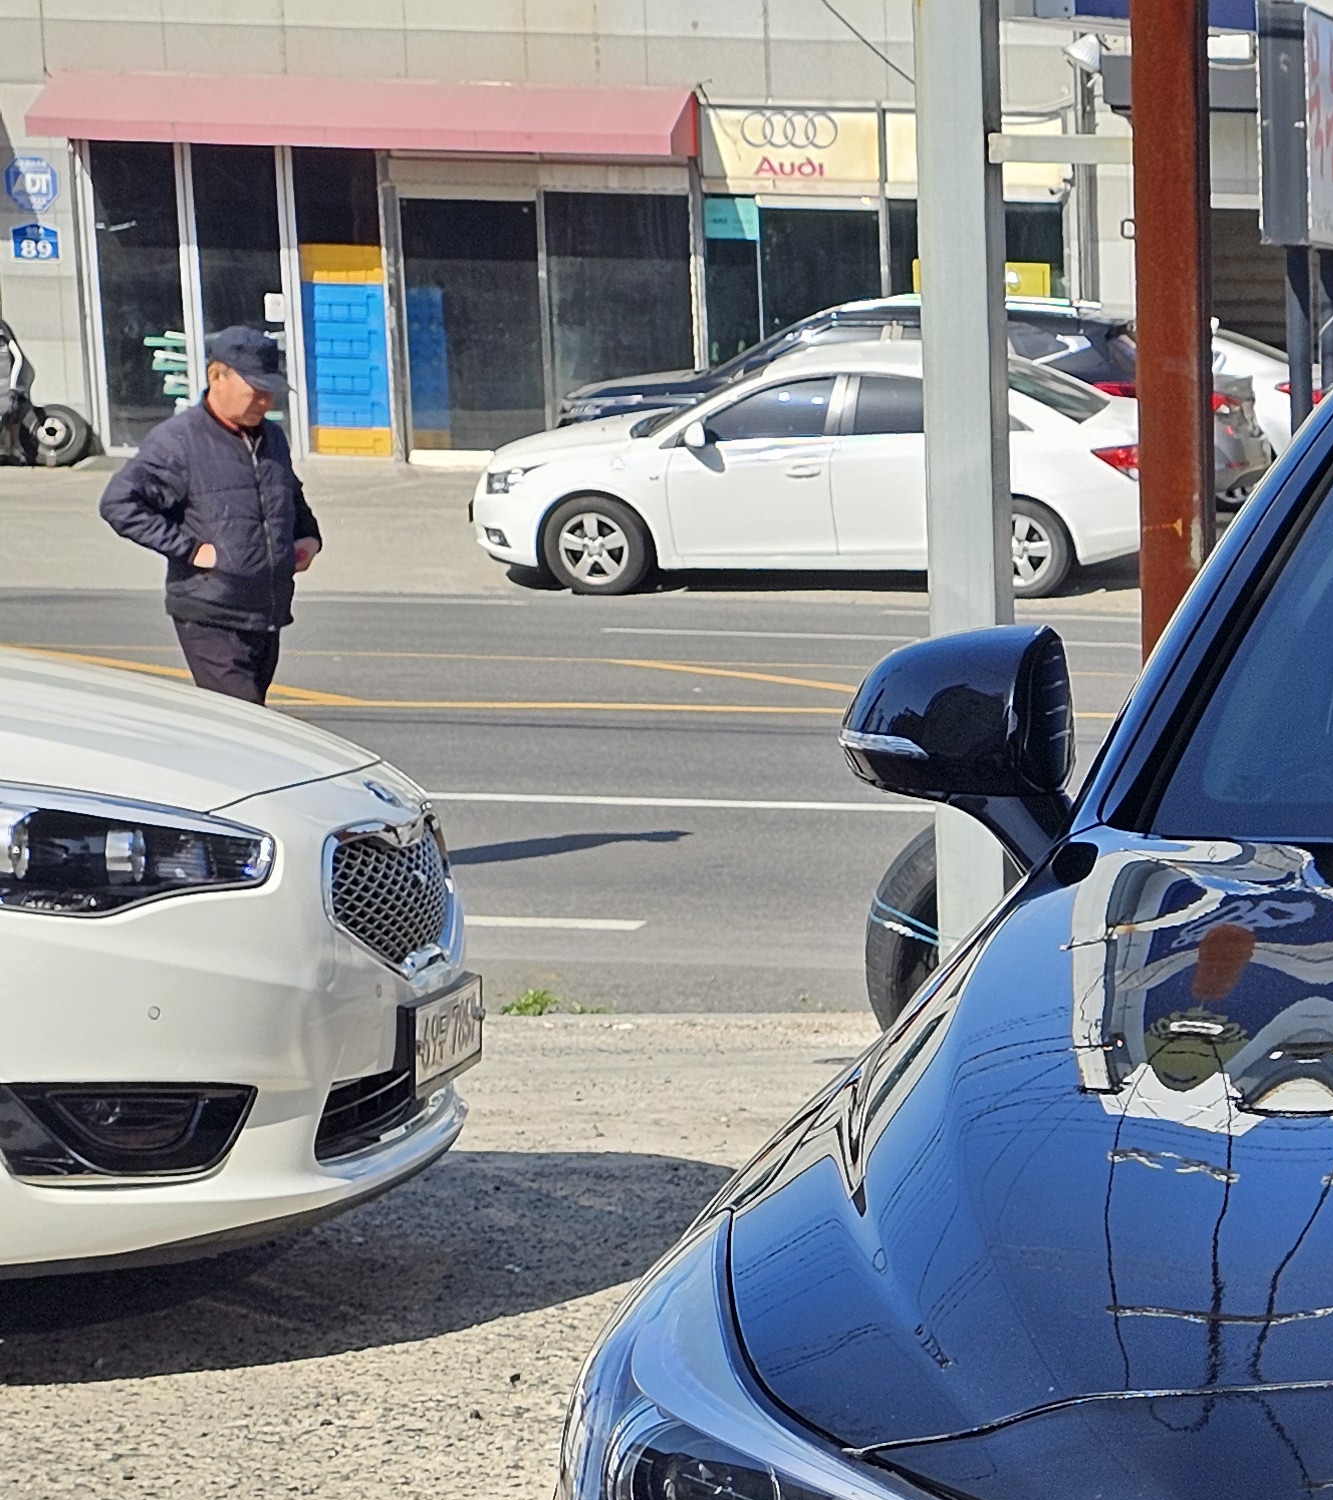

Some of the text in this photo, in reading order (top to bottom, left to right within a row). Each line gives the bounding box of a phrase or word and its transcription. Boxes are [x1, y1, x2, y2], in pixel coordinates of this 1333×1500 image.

[753, 155, 825, 178] Audi
[12, 171, 50, 196] ADT
[20, 239, 53, 259] 89
